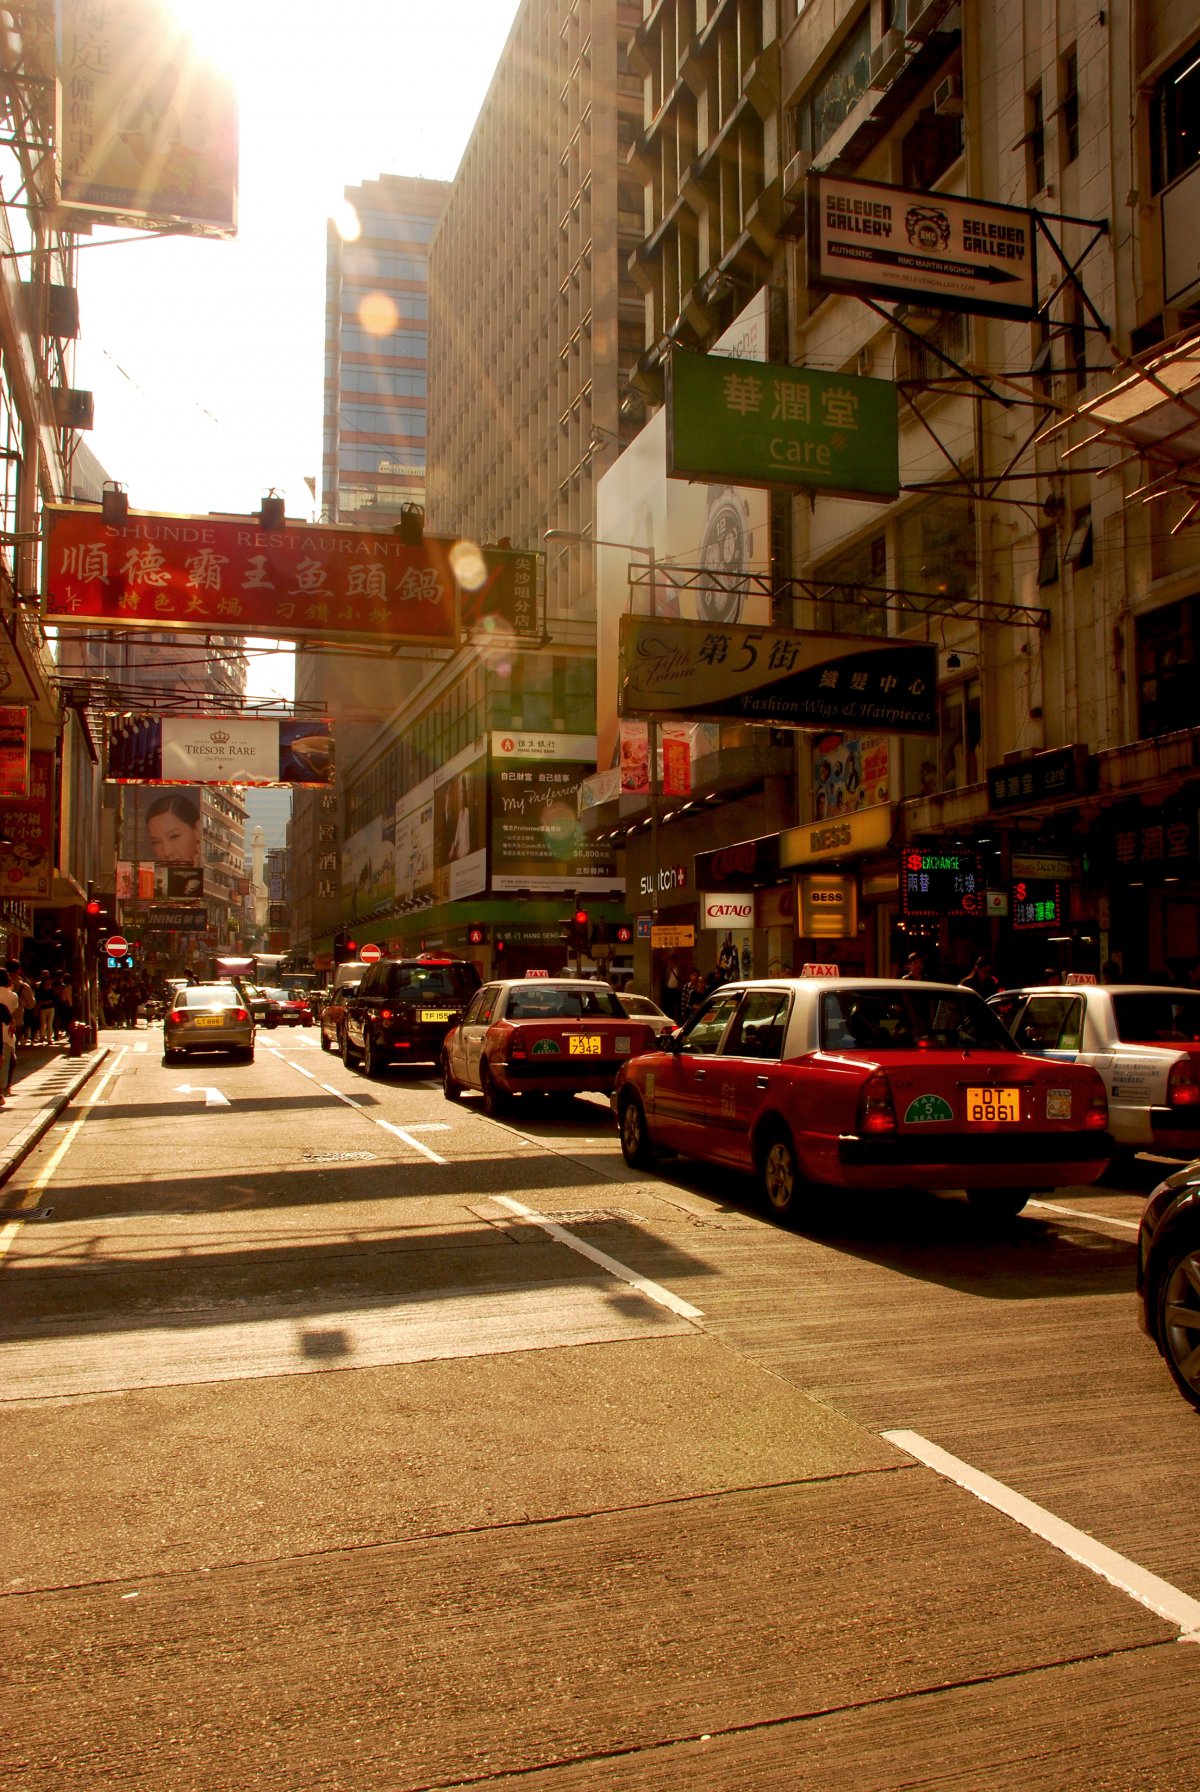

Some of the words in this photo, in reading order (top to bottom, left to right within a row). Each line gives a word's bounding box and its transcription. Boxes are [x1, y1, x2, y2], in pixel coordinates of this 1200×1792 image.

[826, 212, 892, 237] GALLERY
[831, 245, 873, 259] AUTHENTIC
[963, 236, 1025, 260] GALLERY
[915, 259, 943, 272] MARTIN
[722, 373, 859, 430] 華潤堂
[769, 437, 832, 466] care
[105, 524, 216, 544] SHUNDE
[236, 530, 406, 557] RESTAURANT
[60, 542, 445, 605] 順德霸王魚頭鍋
[513, 557, 531, 628] 尖沙咀分店
[699, 632, 802, 673] 第5街
[740, 696, 799, 713] Fashion
[802, 701, 838, 718] Wigs
[859, 703, 932, 722] Hairpieces
[229, 746, 257, 756] RARE
[812, 892, 843, 902] BESS
[707, 904, 752, 918] CATALO
[809, 965, 838, 977] TAXI
[1073, 975, 1096, 985] TAXI
[578, 1036, 592, 1045] KT
[571, 1045, 599, 1054] 7342
[914, 1095, 942, 1108] TAXI
[982, 1089, 1005, 1105] DT
[925, 1103, 934, 1115] 5
[972, 1105, 1015, 1121] 8861
[913, 1113, 945, 1122] SEATS
